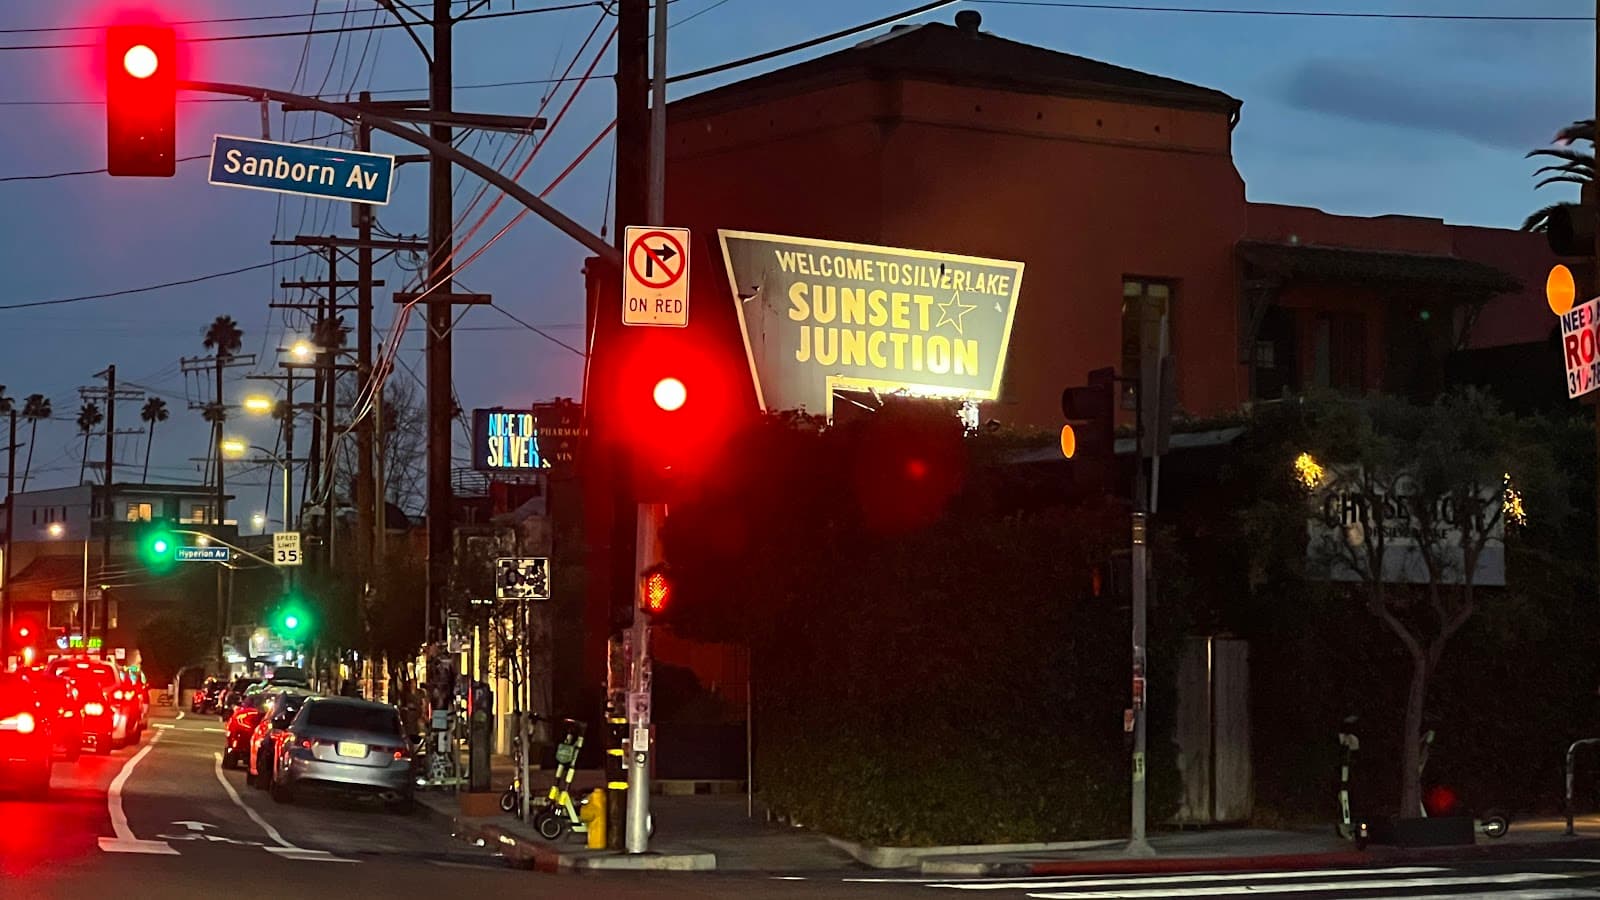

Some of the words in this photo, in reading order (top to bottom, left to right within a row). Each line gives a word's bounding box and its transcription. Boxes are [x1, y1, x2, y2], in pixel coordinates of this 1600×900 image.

[224, 149, 335, 186] Sanborn
[345, 164, 379, 191] Av
[775, 250, 876, 282] WELCOME
[876, 261, 900, 285] TO
[629, 297, 648, 312] ON
[655, 298, 683, 314] RED
[788, 281, 935, 332] SUNSET
[795, 325, 979, 376] JUNCTION
[488, 413, 515, 436] NICE
[517, 413, 533, 436] TO
[179, 550, 213, 559] Hyperion
[215, 549, 226, 557] Av
[278, 550, 297, 562] 35
